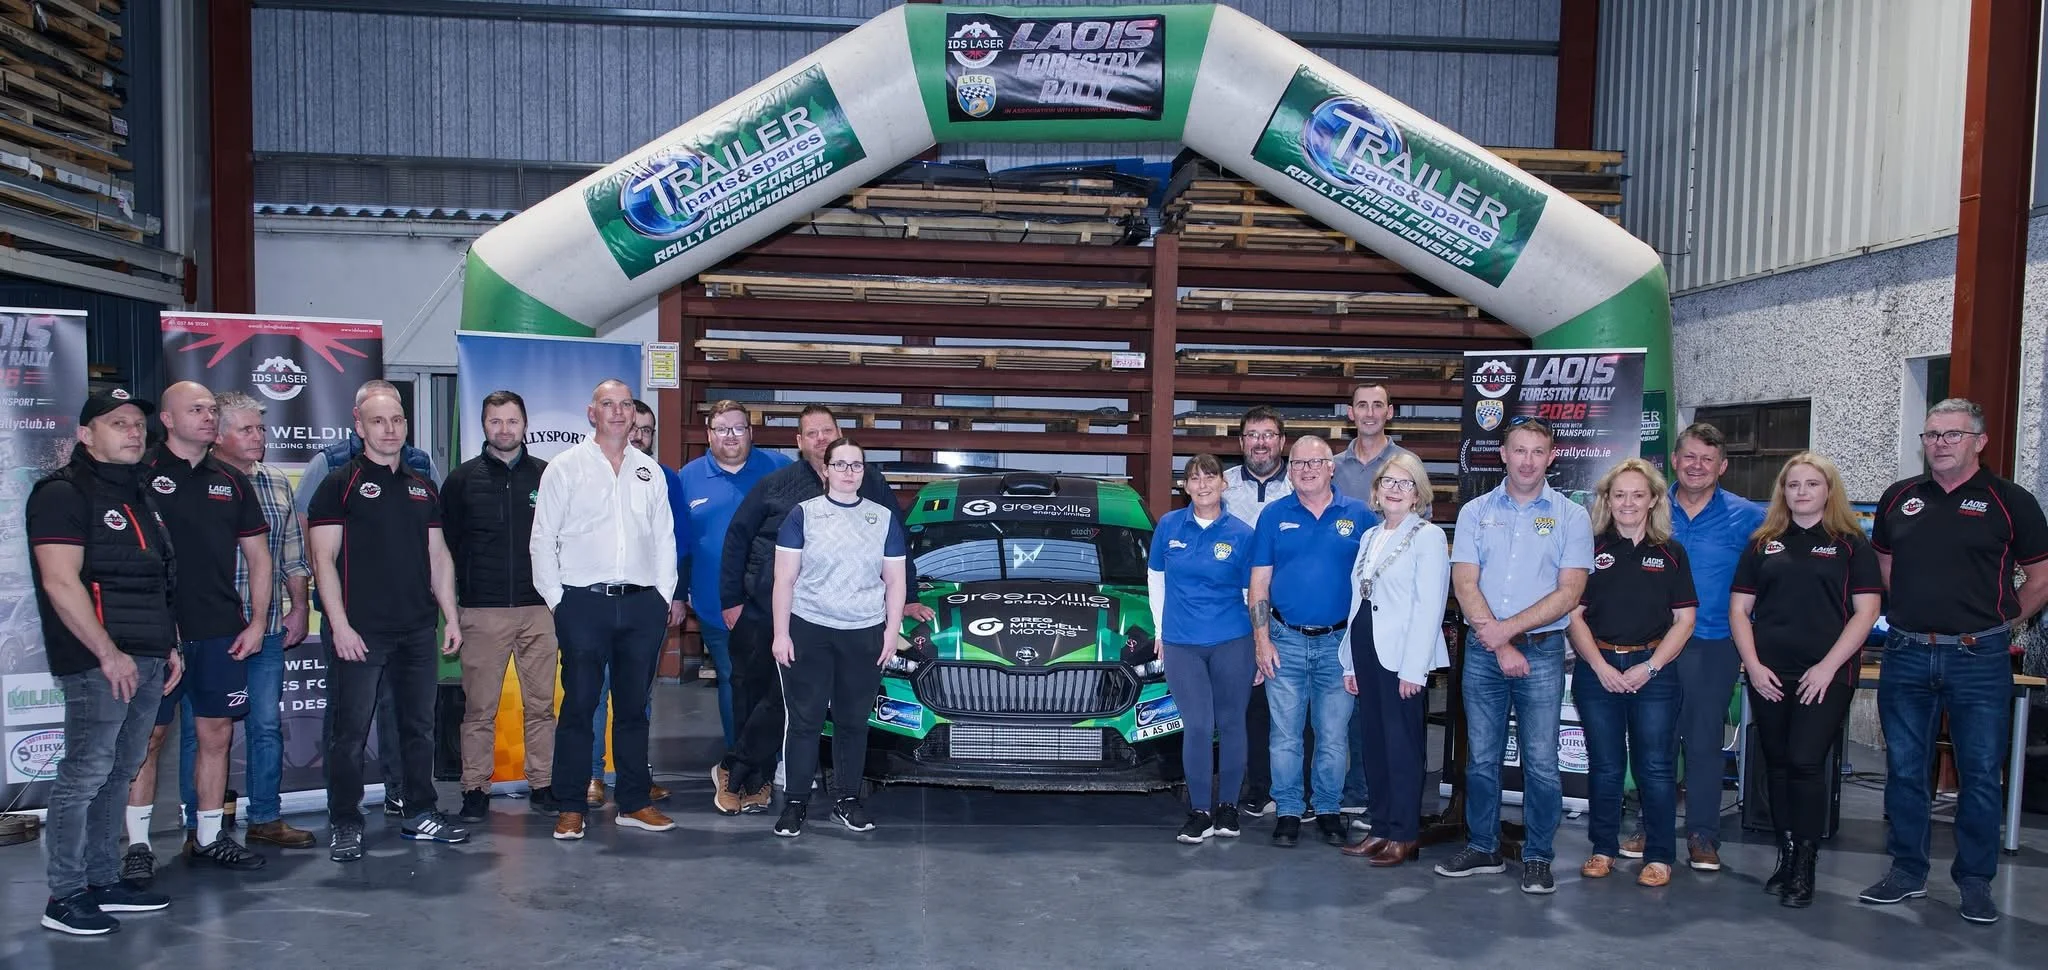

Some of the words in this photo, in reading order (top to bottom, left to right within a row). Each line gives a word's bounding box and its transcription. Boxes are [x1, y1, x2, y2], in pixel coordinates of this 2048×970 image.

[948, 40, 968, 49] IDS
[970, 39, 1004, 48] LASER
[1008, 20, 1158, 51] LAOIS
[1016, 52, 1144, 78] FORESTRY
[962, 76, 990, 84] LRSC
[1038, 80, 1116, 104] RALLY
[633, 106, 818, 217] TRAILER
[1331, 108, 1508, 231] TRAILER
[685, 132, 822, 214] parts&spares
[707, 189, 752, 222] IRISH
[757, 149, 826, 192] FOREST
[1350, 161, 1492, 244] parts&spares
[653, 230, 705, 264] RALLY
[710, 161, 834, 237] CHAMPIONSHIP
[1284, 164, 1343, 198] RALLY
[1342, 194, 1475, 268] CHAMPIONSHIP
[1354, 185, 1400, 216] IRISH
[1405, 211, 1483, 256] FOREST
[9, 350, 54, 367] RALLY
[252, 374, 272, 382] IDS
[274, 374, 308, 384] LASER
[1522, 356, 1618, 386] LAOIS
[1518, 387, 1578, 400] FORESTRY
[1578, 386, 1616, 400] RALLY
[1539, 404, 1587, 420] 2026
[932, 500, 940, 510] 1
[1002, 503, 1091, 514] greenville
[947, 593, 1110, 604] greenville
[1062, 600, 1110, 608] limited
[1010, 623, 1088, 632] MITCHELL
[1010, 628, 1077, 637] MOTORS
[1152, 726, 1164, 735] AS
